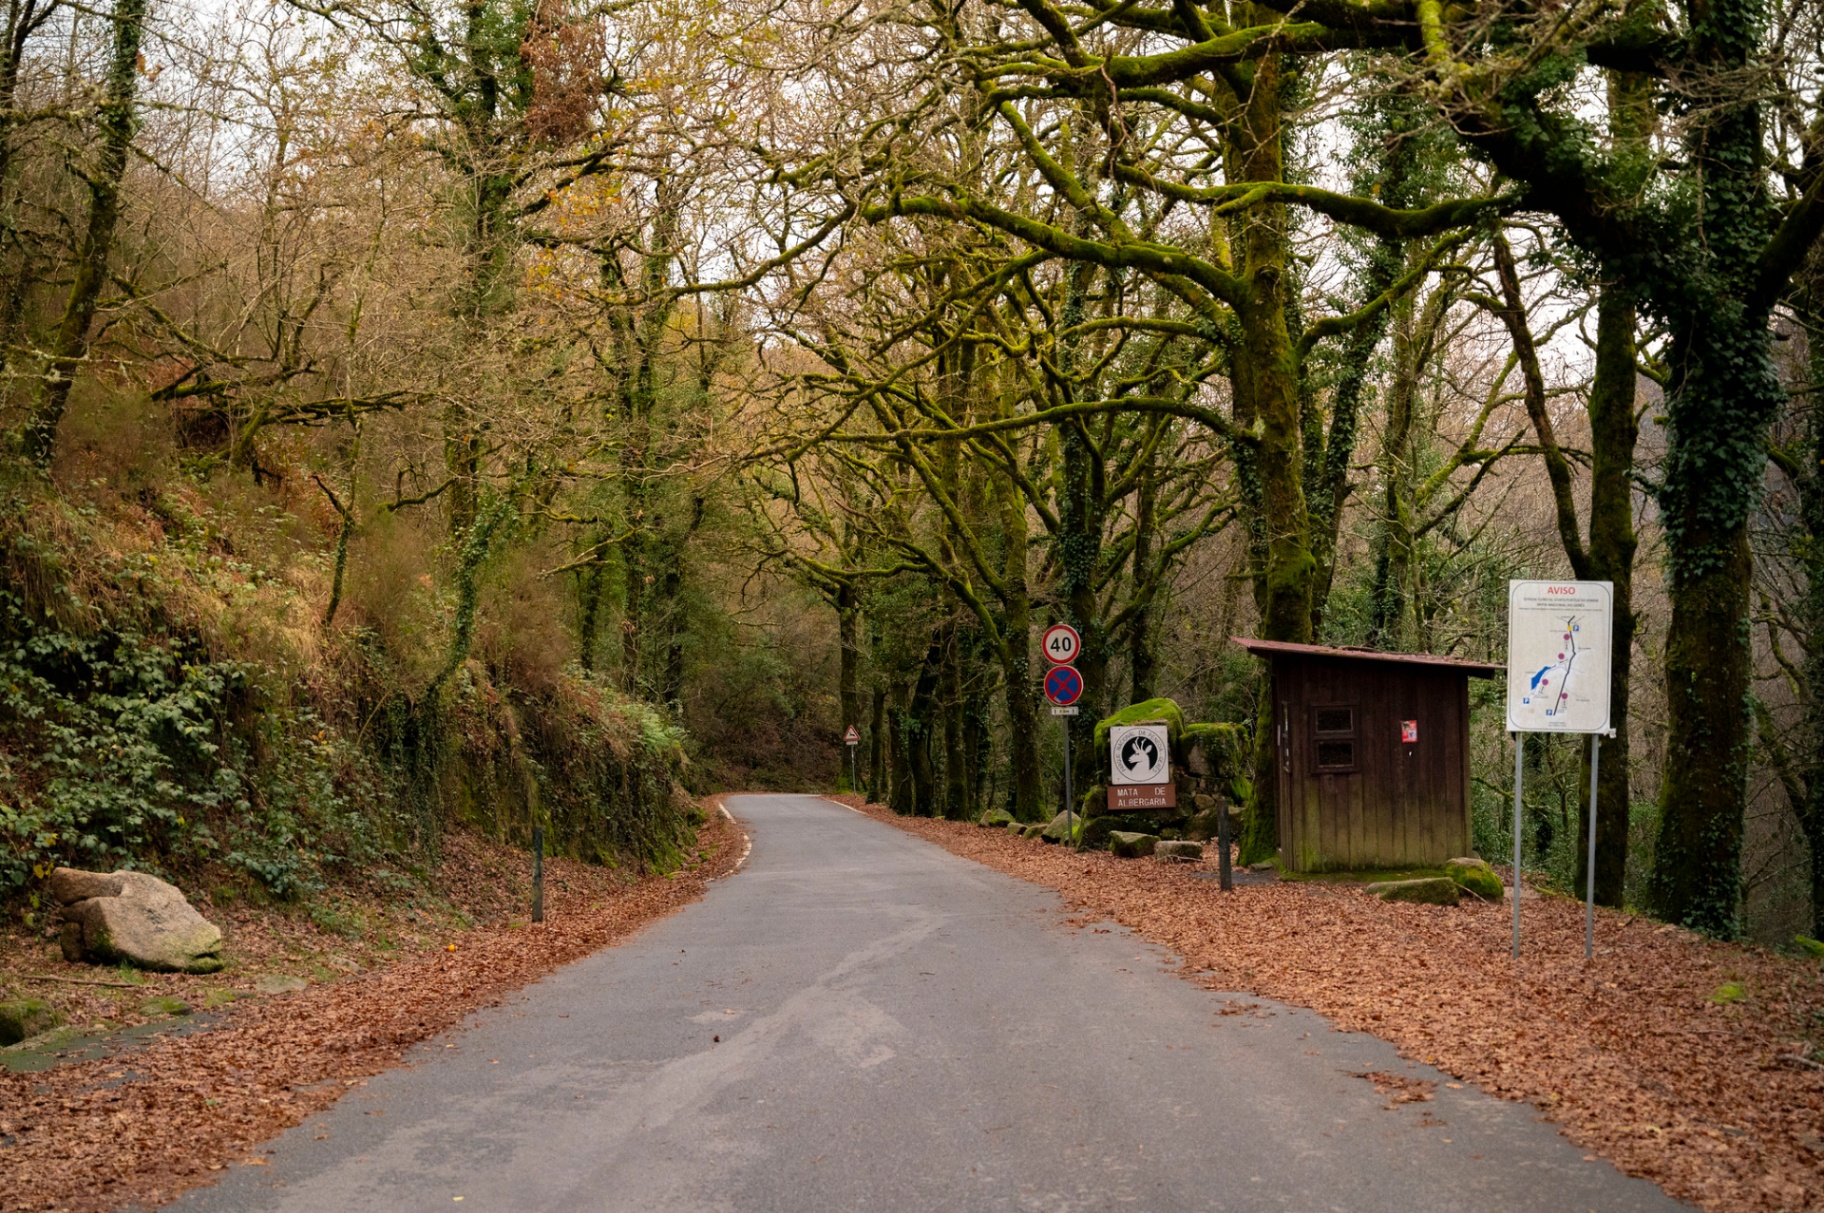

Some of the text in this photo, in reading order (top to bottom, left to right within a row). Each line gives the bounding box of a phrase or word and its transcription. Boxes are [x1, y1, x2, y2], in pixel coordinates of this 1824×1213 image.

[1547, 586, 1576, 595] AVISO
[1050, 636, 1072, 652] 40
[1117, 787, 1166, 797] MATA DE
[1118, 797, 1166, 807] ALBERGARIA
